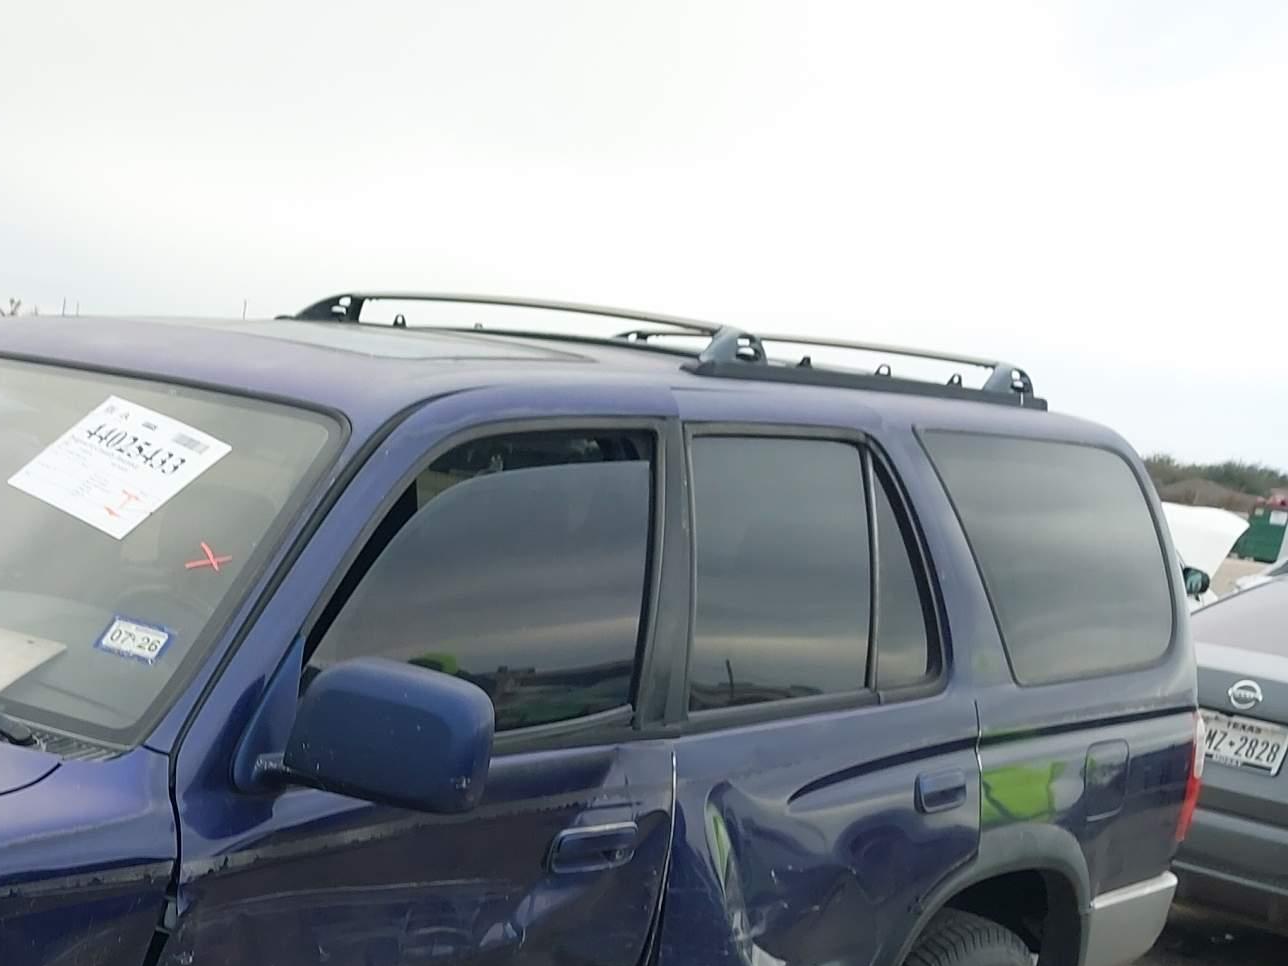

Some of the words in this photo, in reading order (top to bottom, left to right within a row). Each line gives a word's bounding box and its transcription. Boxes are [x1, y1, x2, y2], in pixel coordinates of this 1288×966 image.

[86, 423, 187, 474] 44025433
[110, 629, 135, 644] 07
[137, 636, 161, 652] 26
